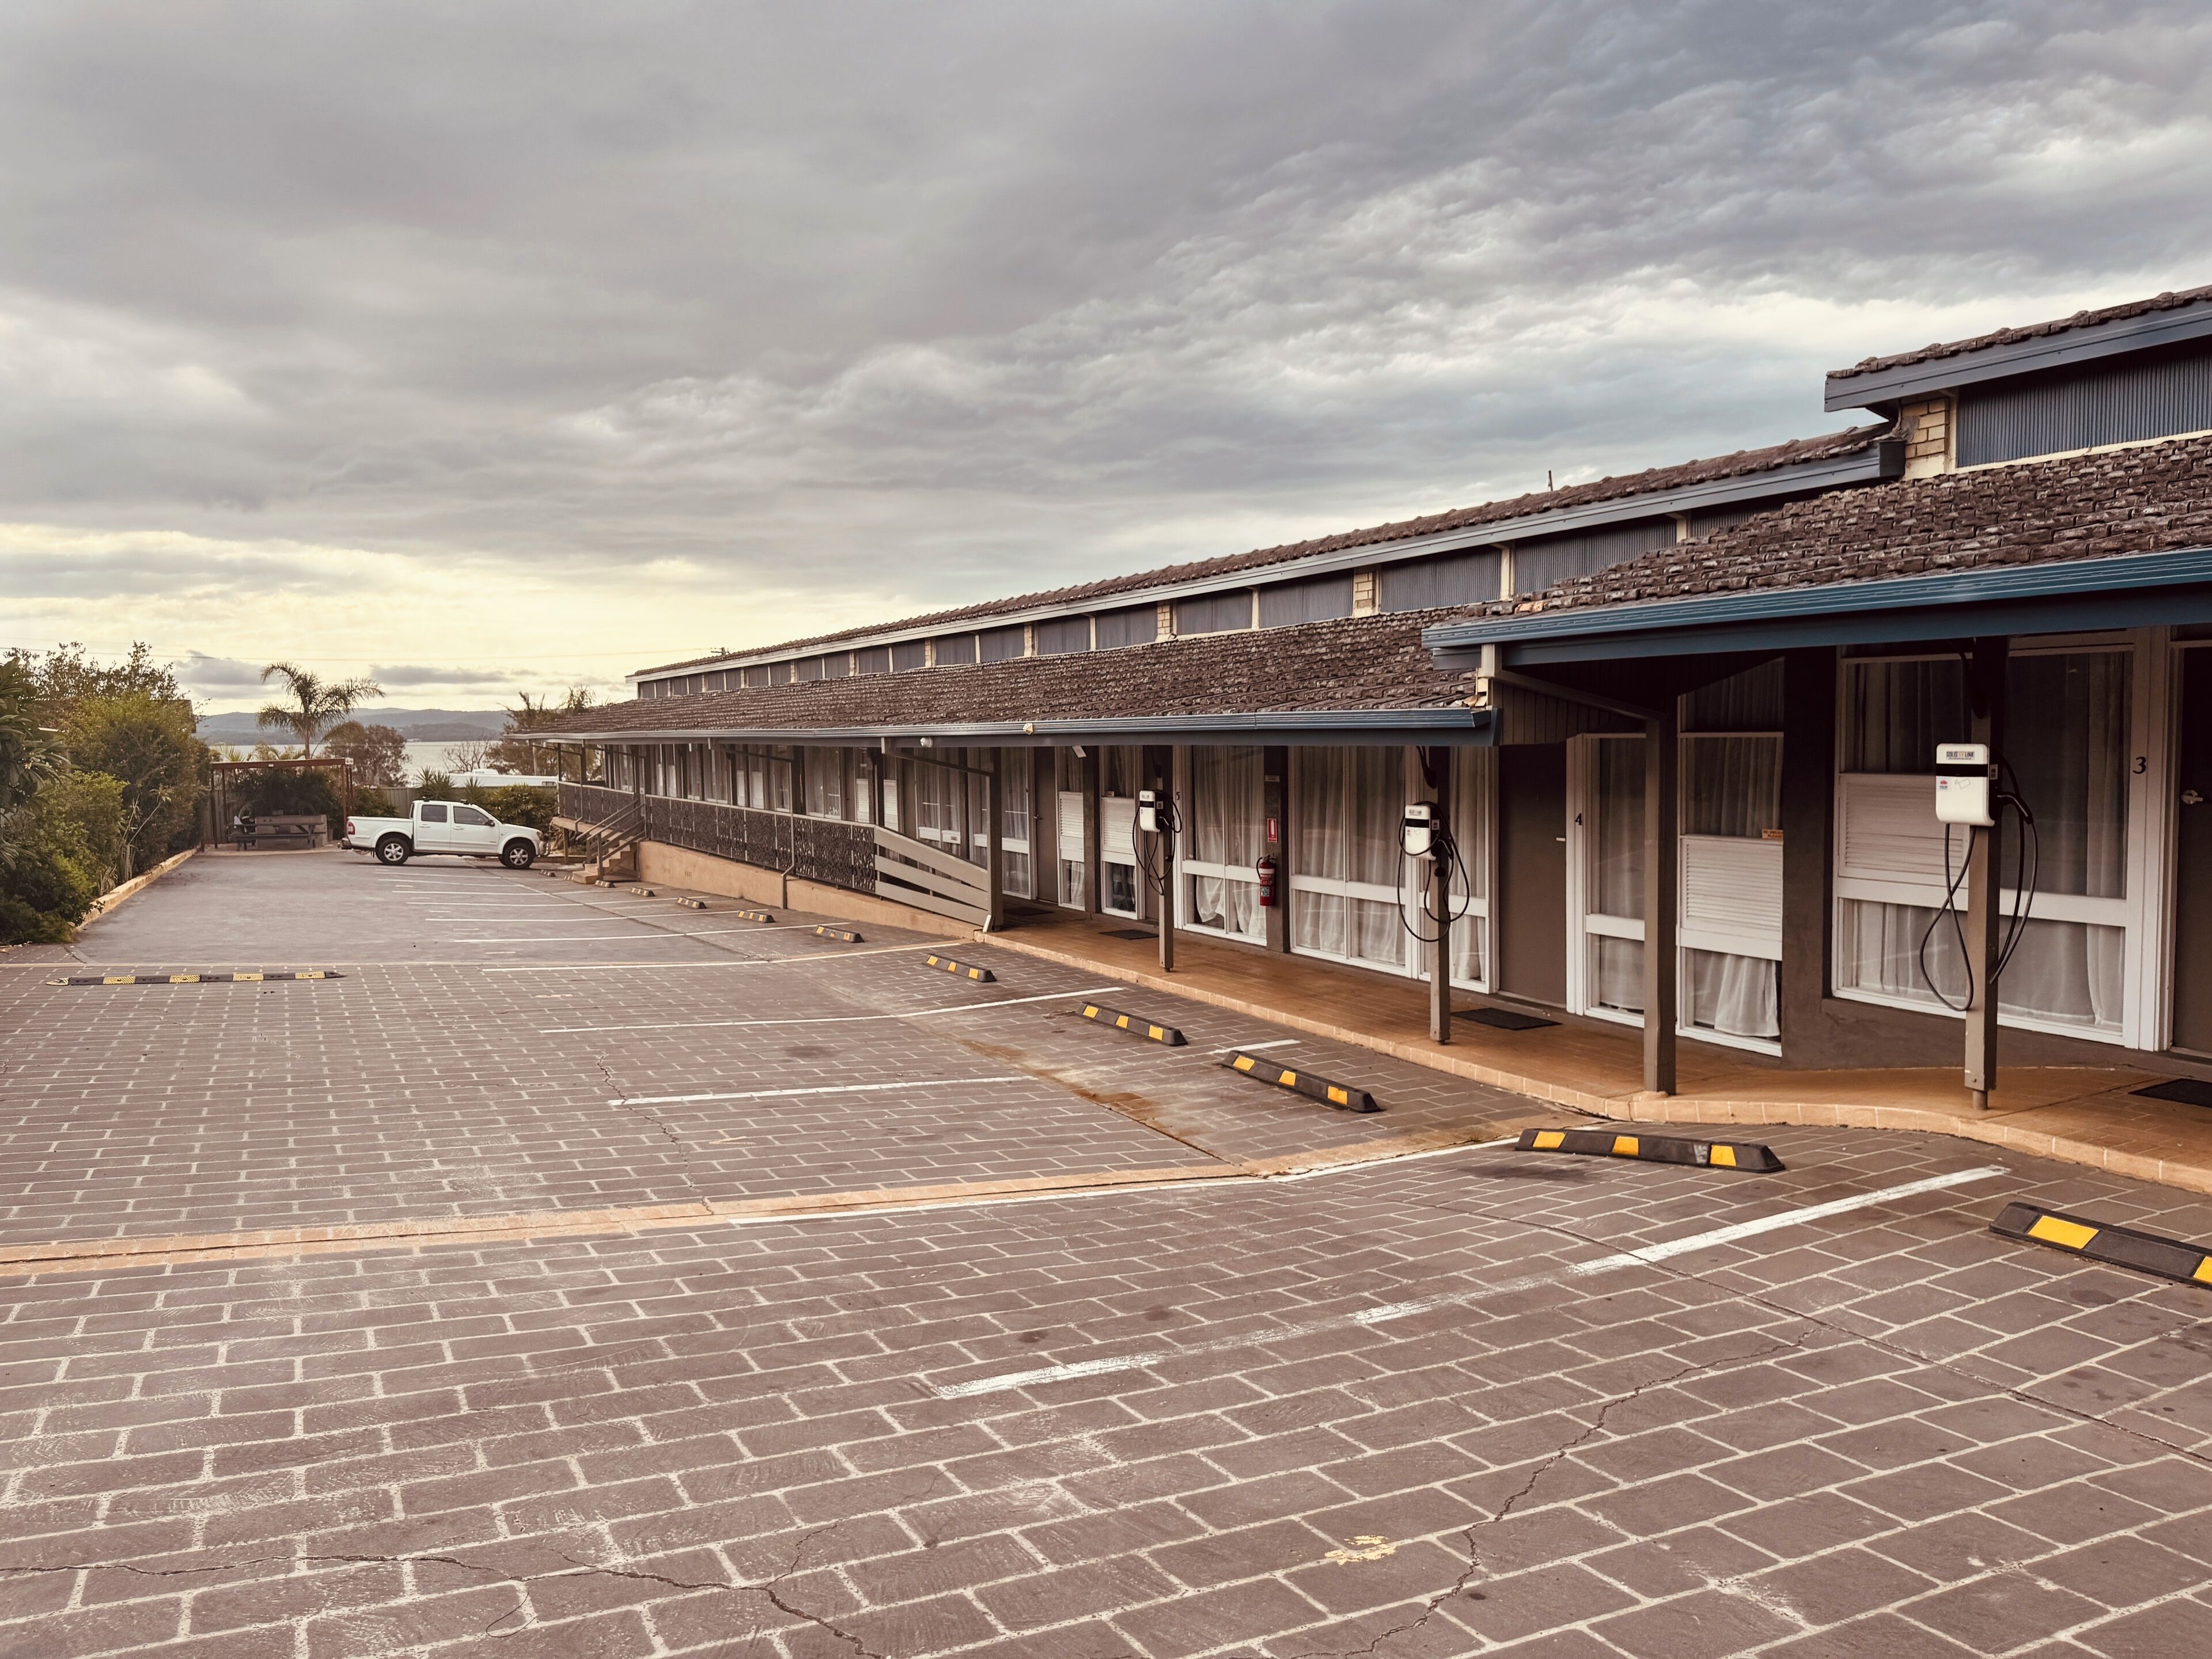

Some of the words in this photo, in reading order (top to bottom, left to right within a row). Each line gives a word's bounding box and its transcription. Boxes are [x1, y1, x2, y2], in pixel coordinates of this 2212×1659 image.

[2133, 756, 2146, 774] 3
[1176, 792, 1180, 800] 5
[1574, 813, 1582, 825] 4
